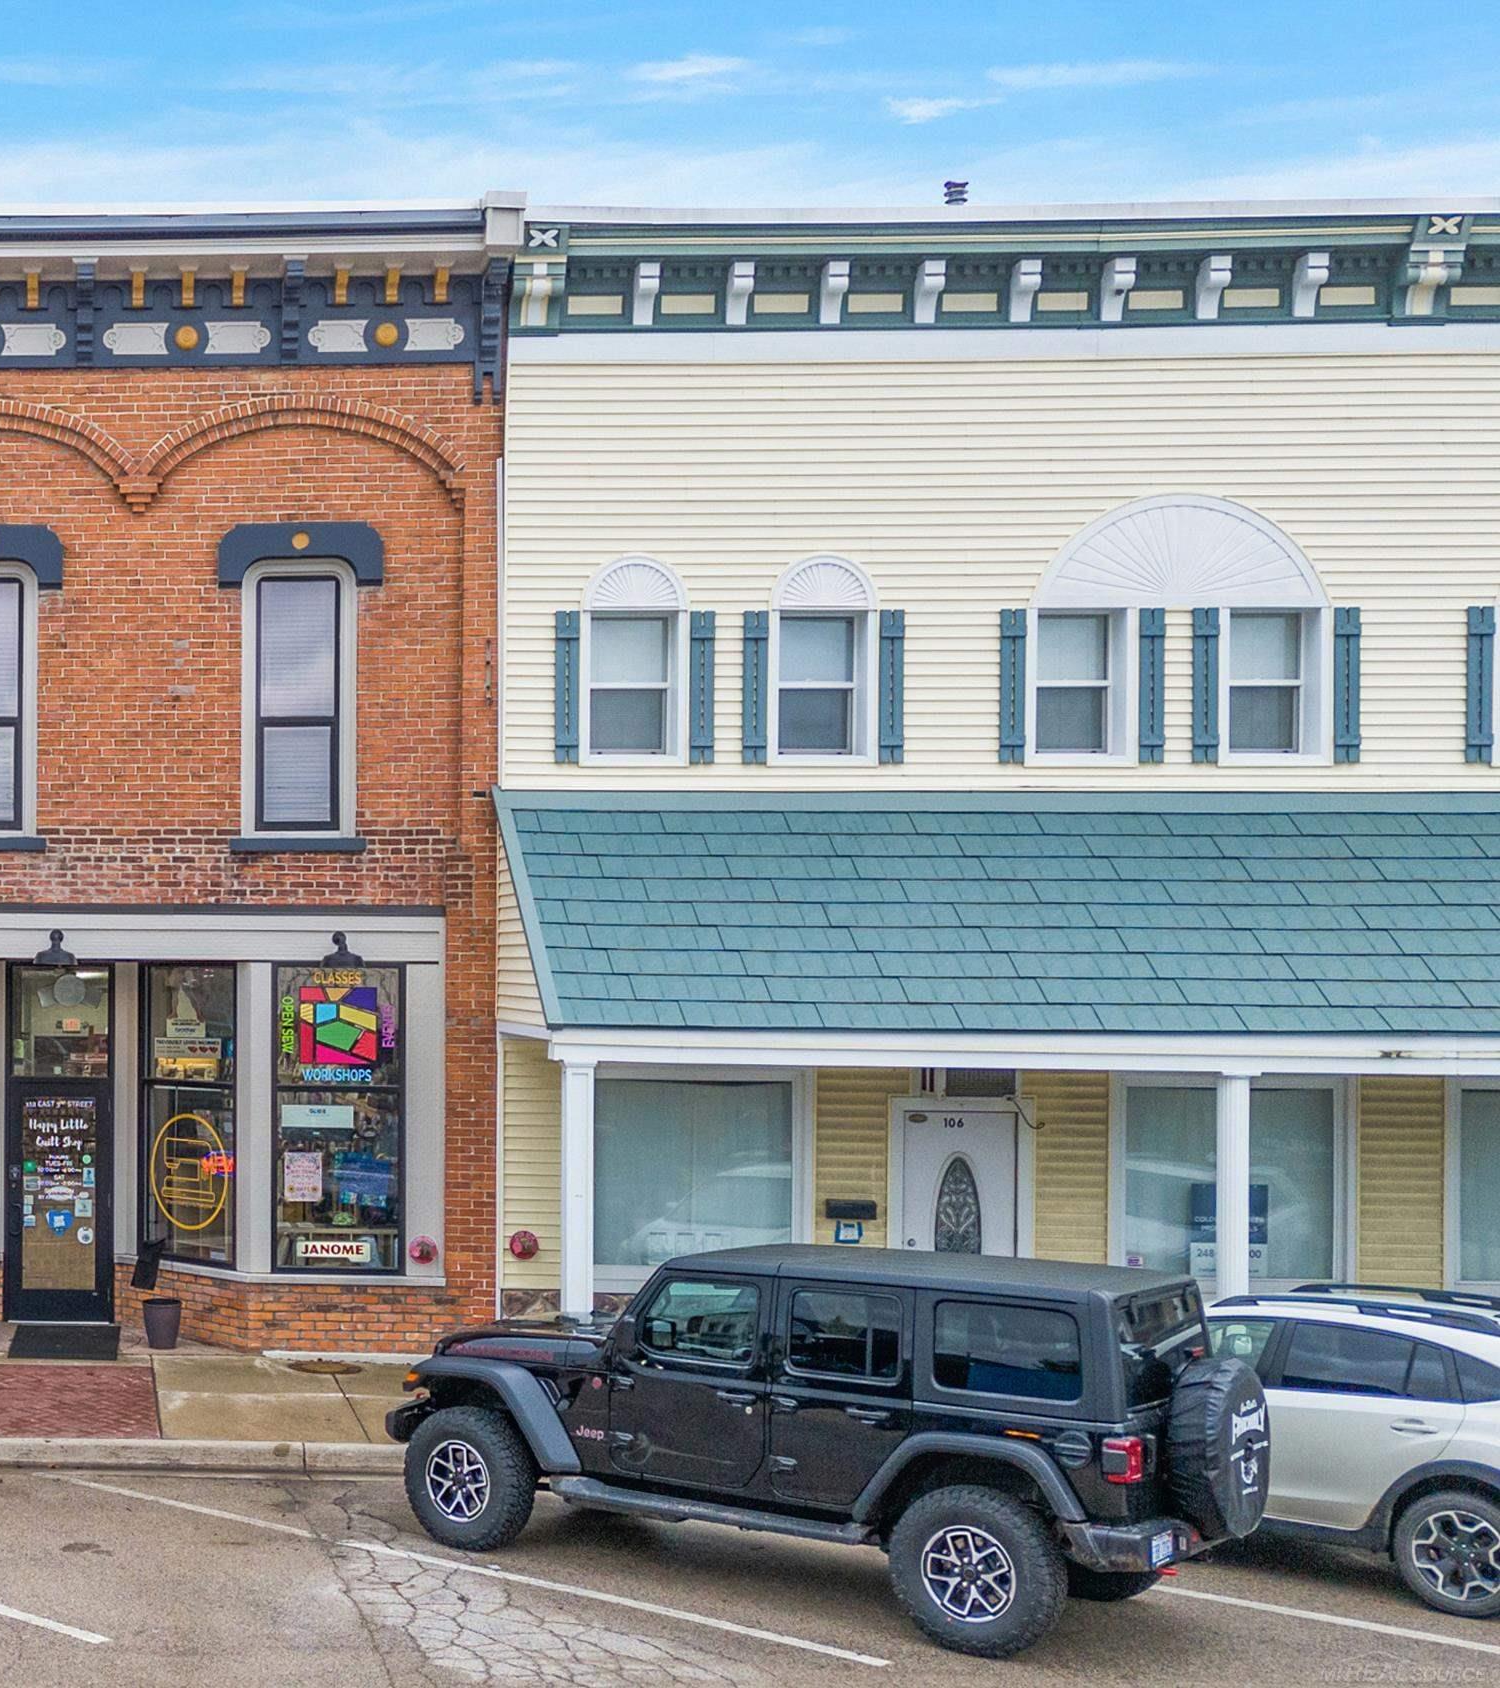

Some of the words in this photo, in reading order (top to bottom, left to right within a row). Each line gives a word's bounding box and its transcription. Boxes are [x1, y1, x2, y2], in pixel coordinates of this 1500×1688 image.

[313, 971, 362, 985] CLASSES
[282, 996, 294, 1024] OPEN
[382, 1005, 395, 1048] EVENTS
[282, 1027, 294, 1054] SEW
[302, 1068, 372, 1081] WORKSHOPS
[29, 1118, 58, 1133] Happy
[943, 1118, 964, 1128] 106
[62, 1135, 83, 1151] Shop
[301, 1244, 364, 1255] JANOME
[576, 1425, 605, 1440] Jeep
